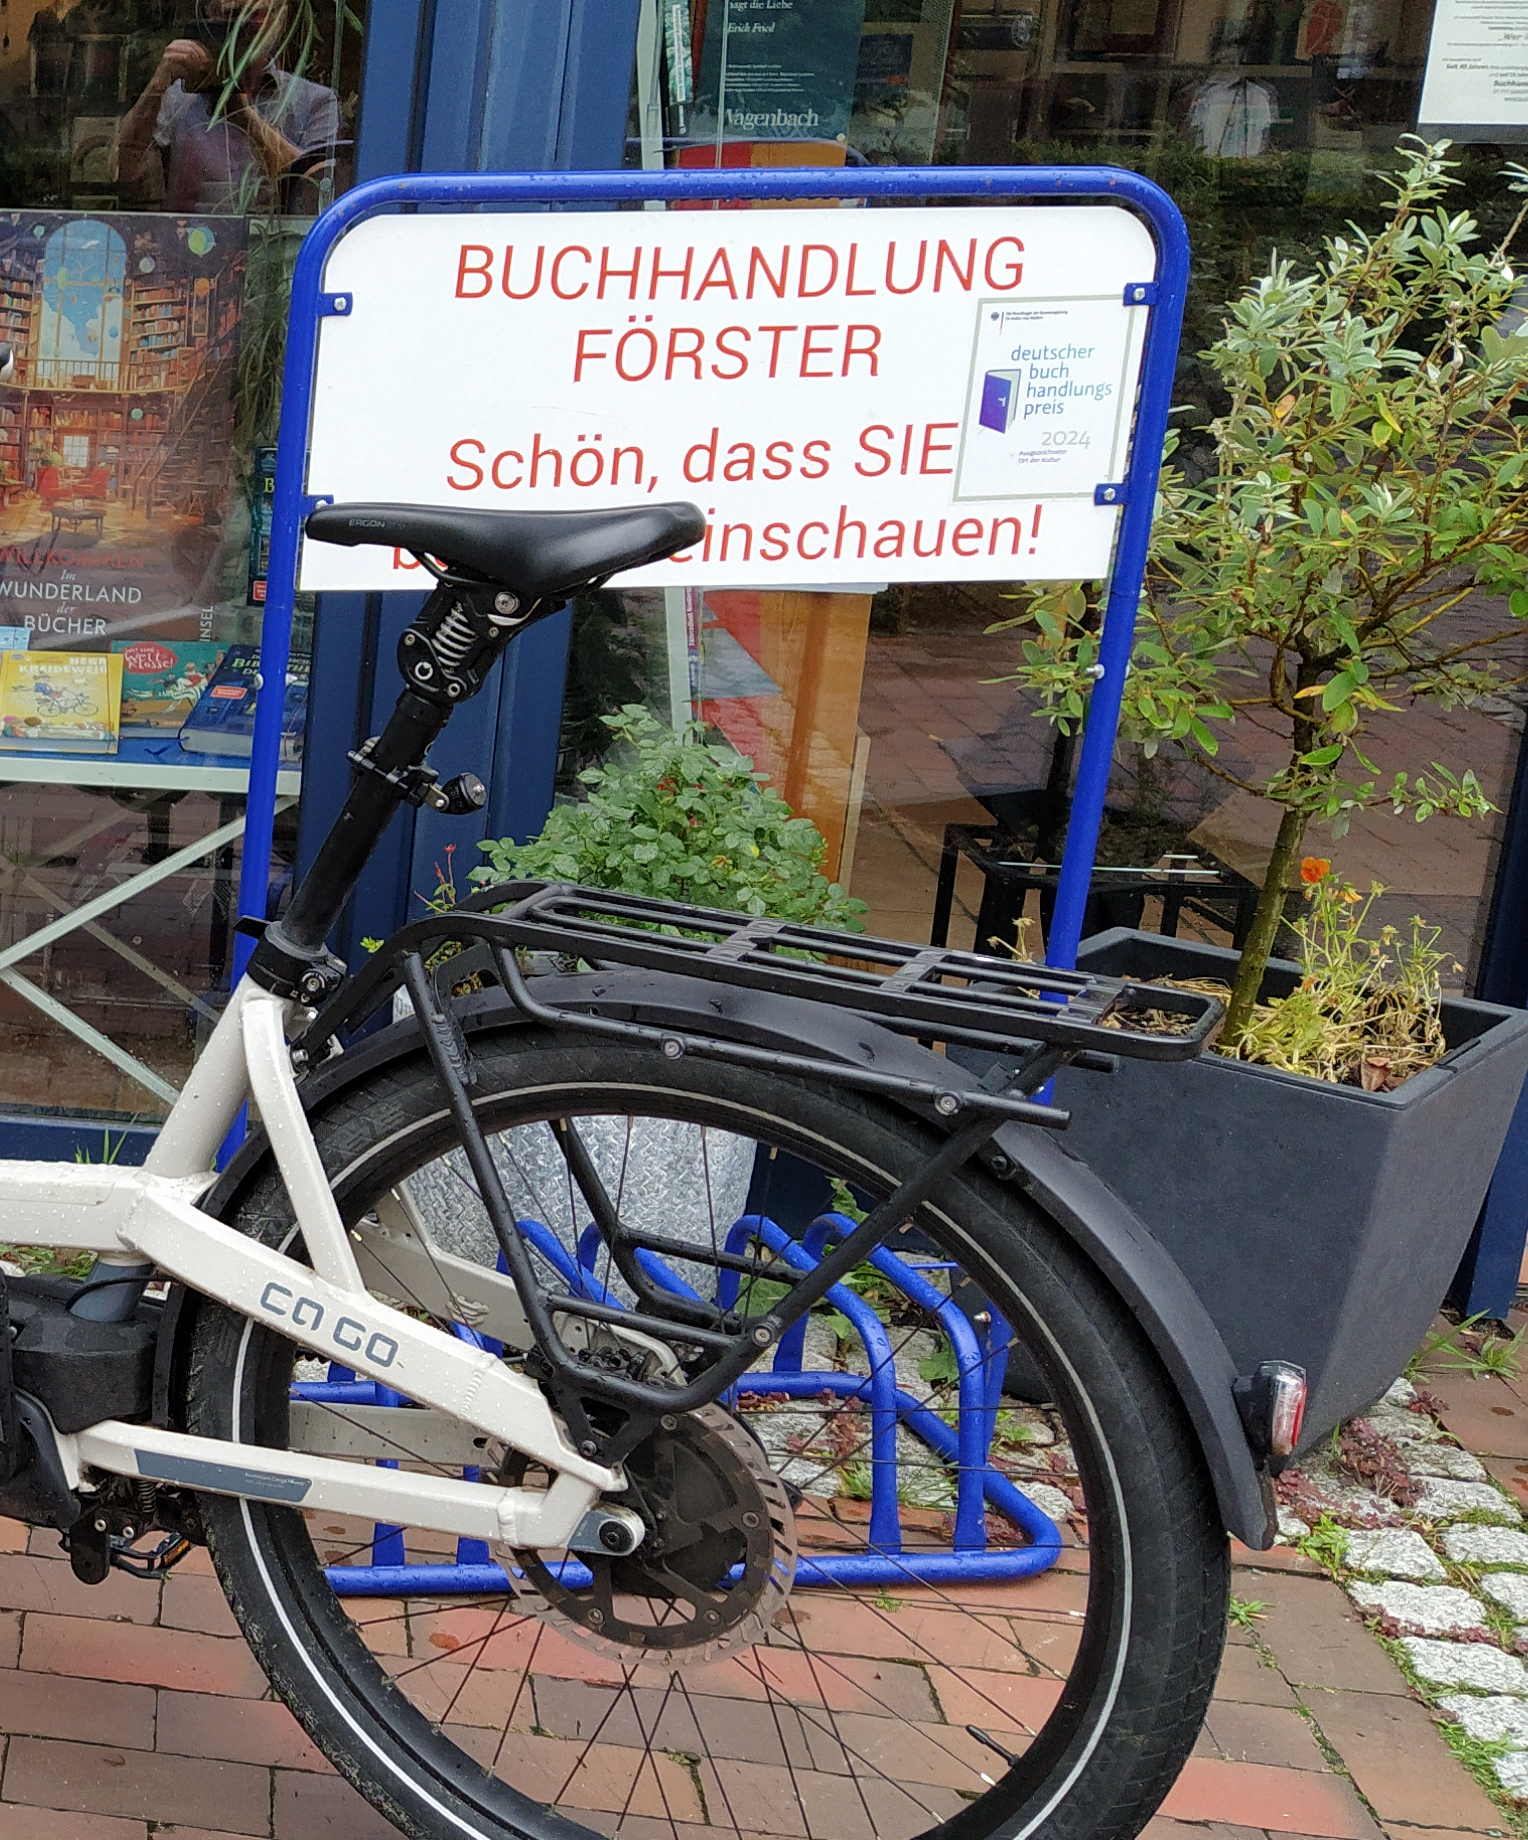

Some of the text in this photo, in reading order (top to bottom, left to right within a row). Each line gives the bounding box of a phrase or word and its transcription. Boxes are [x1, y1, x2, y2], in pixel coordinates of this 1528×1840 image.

[766, 0, 793, 10] Liebe
[727, 22, 775, 33] Erich Fried
[454, 236, 1026, 301] BUCHHANDLUNG
[573, 315, 882, 383] FÖRSTER
[1011, 343, 1095, 361] deutscher
[1029, 361, 1069, 379] buch
[1026, 380, 1113, 401] handlungs
[1023, 398, 1065, 420] preis
[1041, 430, 1091, 449] 2024
[446, 421, 960, 492] Schön, dass SIE
[348, 518, 386, 528] ERGON
[59, 569, 76, 581] Im
[56, 602, 78, 614] der
[24, 613, 108, 635] BÜCHER
[200, 605, 214, 642] INSEL
